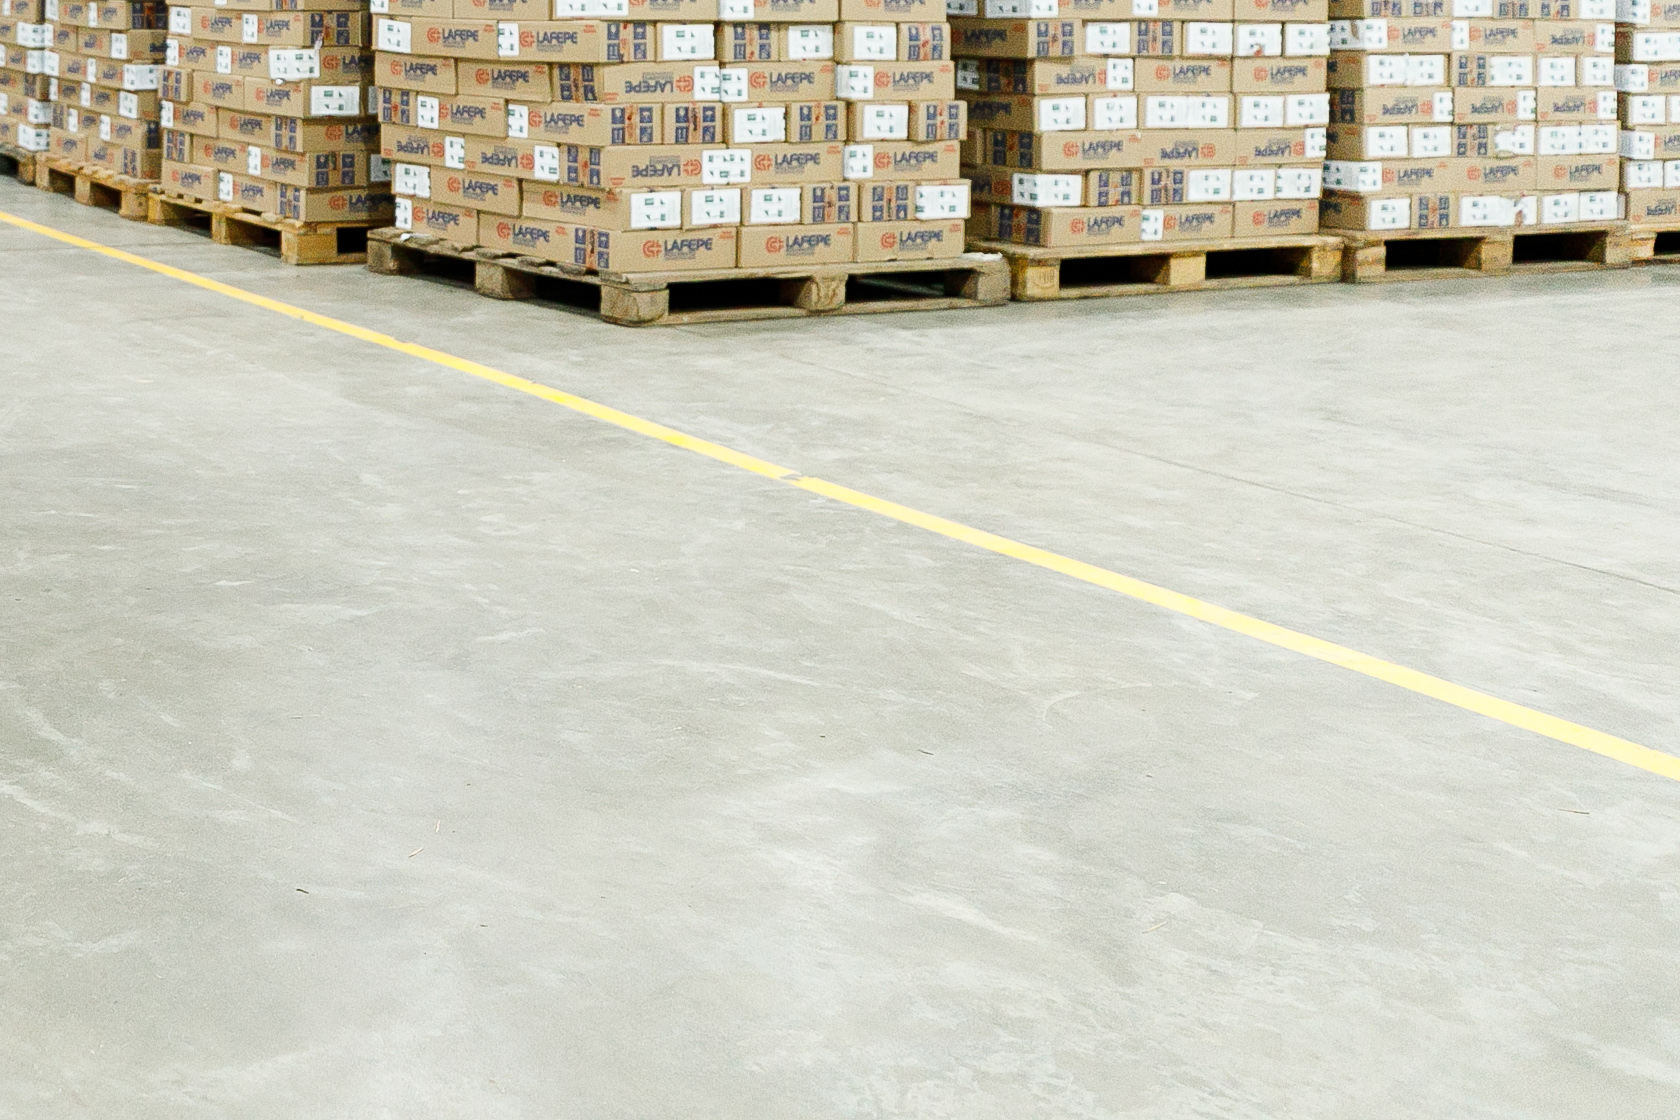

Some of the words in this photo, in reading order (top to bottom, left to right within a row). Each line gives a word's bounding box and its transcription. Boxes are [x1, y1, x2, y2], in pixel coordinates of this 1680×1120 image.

[786, 234, 831, 248] LAFEPE
[899, 230, 943, 243] LAFEPE
[664, 238, 713, 251] LAFEPE
